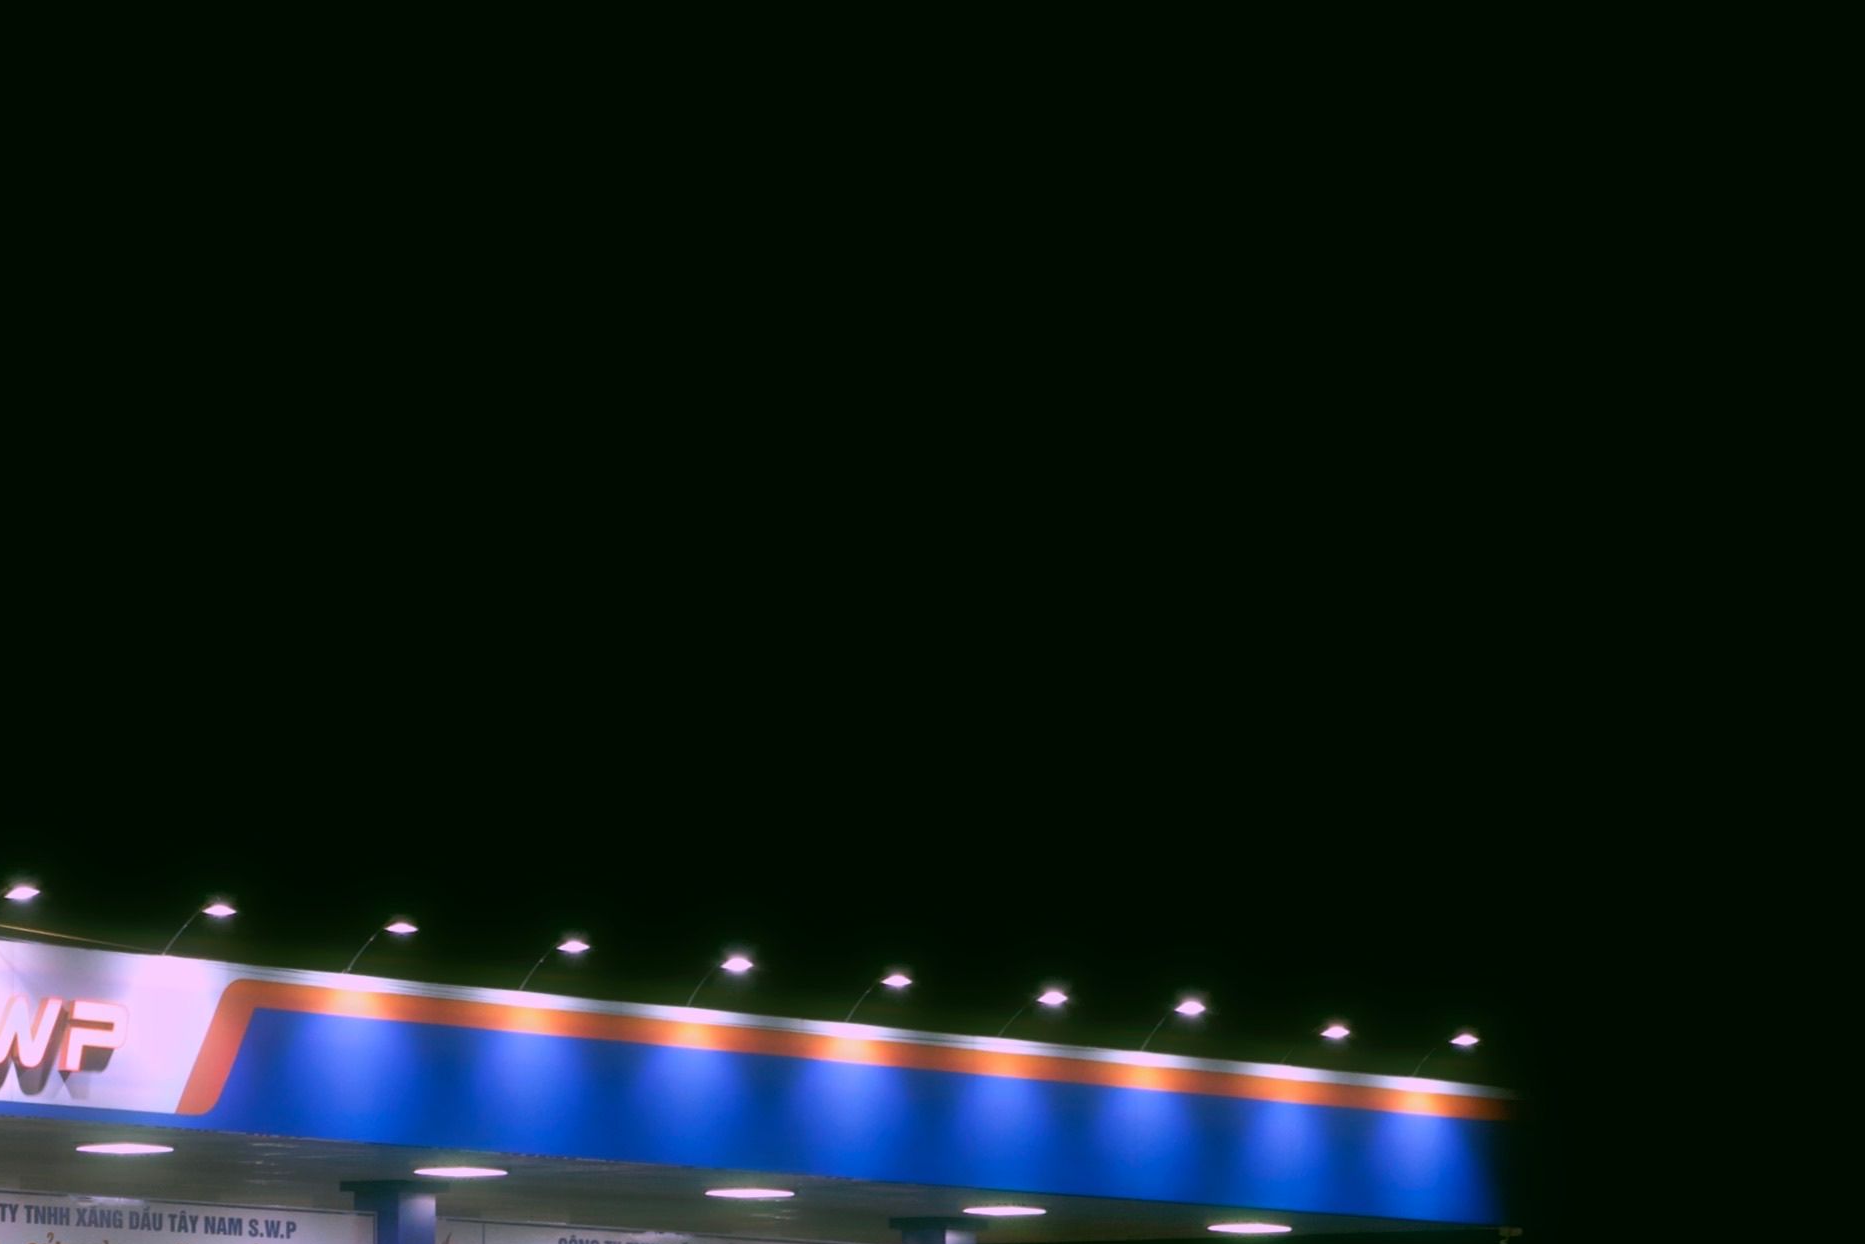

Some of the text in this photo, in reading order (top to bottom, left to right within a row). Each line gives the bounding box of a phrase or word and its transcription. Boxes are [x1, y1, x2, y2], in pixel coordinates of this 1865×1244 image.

[0, 1203, 20, 1222] TY
[24, 1204, 70, 1225] TNHH
[75, 1204, 123, 1229] XĂNG
[129, 1206, 162, 1231] DẦU
[168, 1210, 200, 1233] TÂY
[204, 1216, 243, 1236] NAM
[248, 1219, 297, 1239] S.W.P
